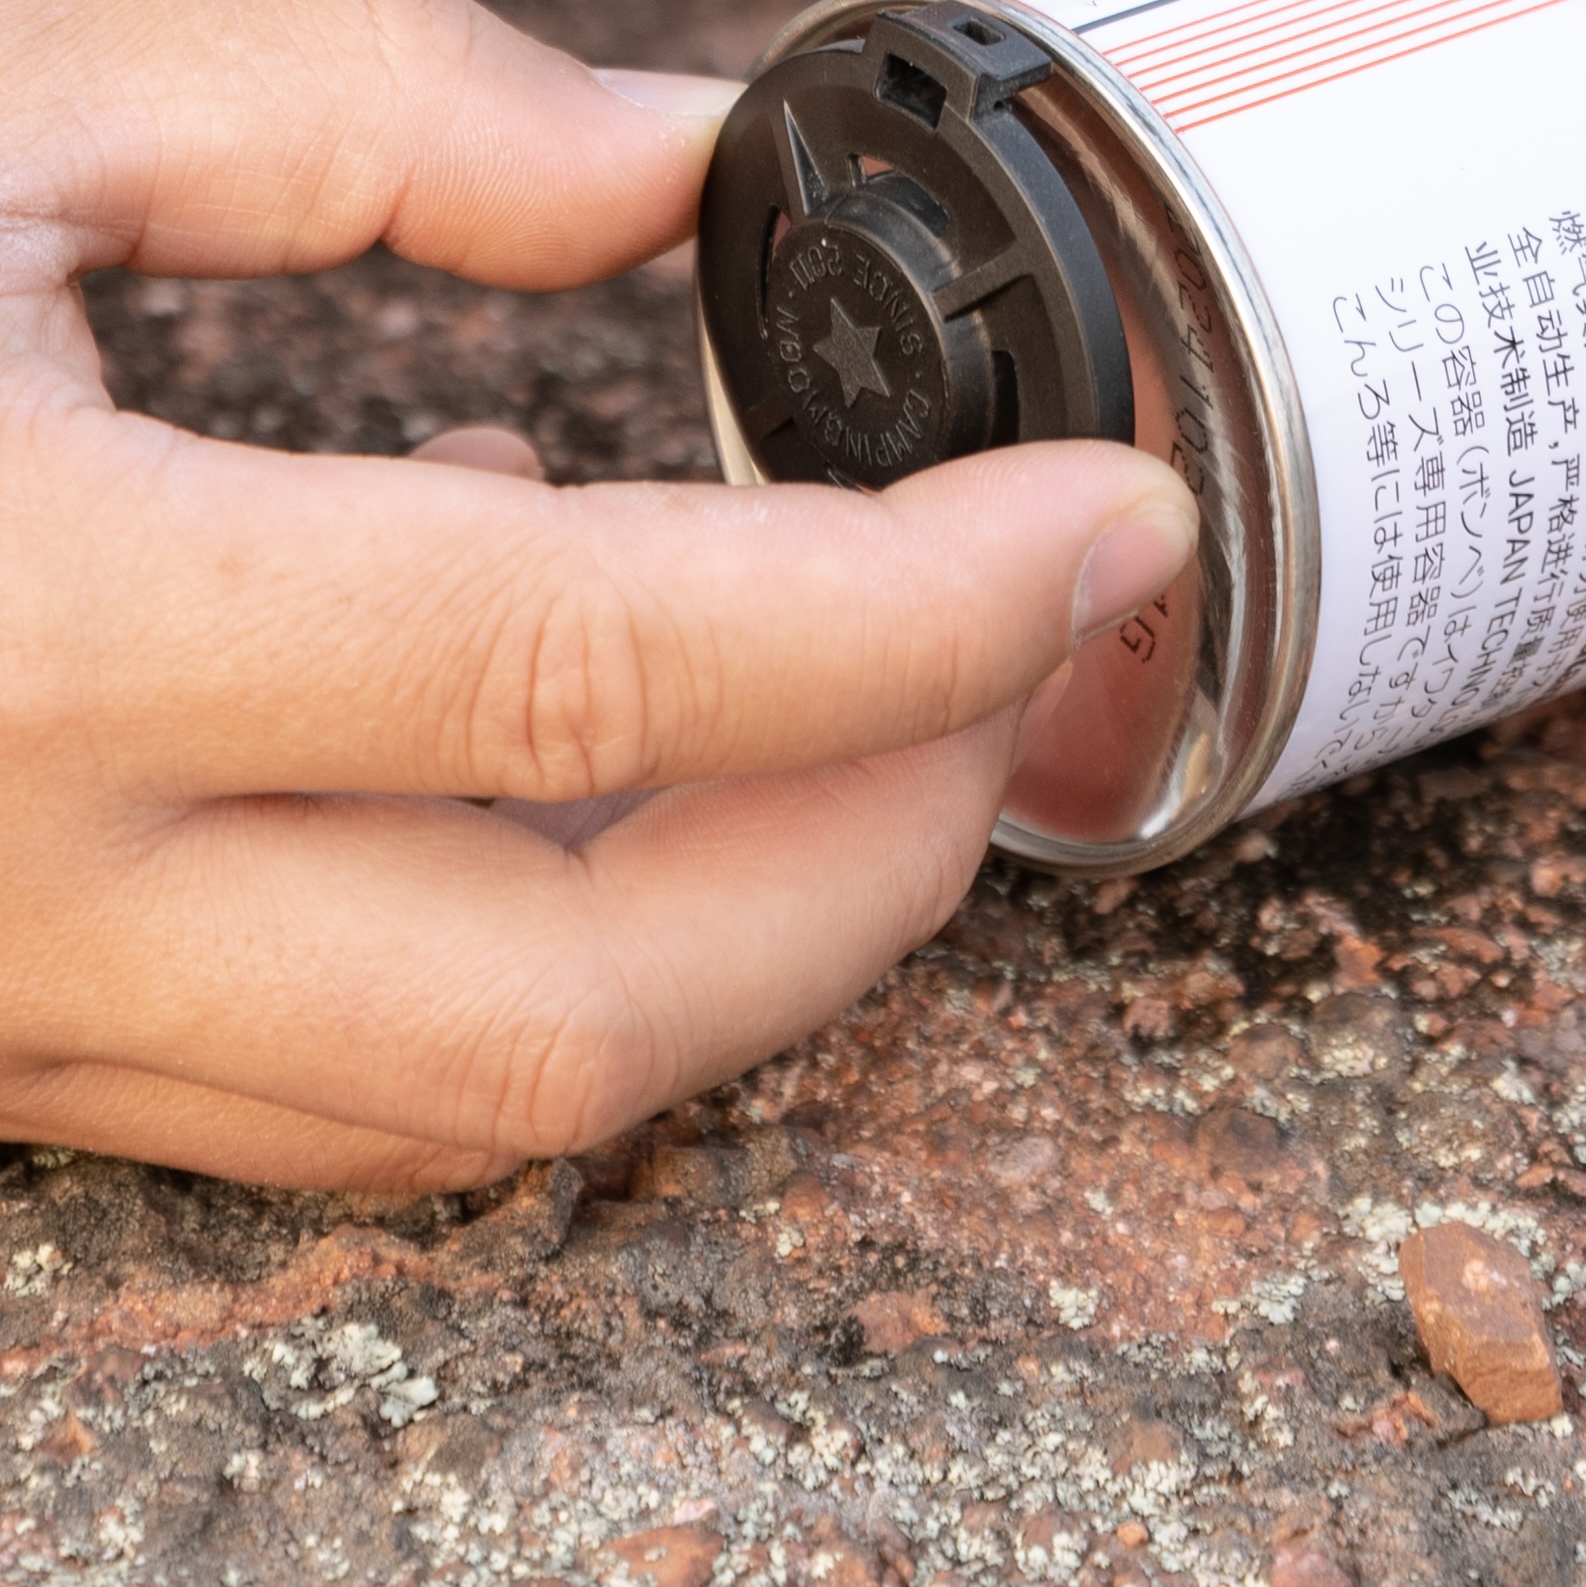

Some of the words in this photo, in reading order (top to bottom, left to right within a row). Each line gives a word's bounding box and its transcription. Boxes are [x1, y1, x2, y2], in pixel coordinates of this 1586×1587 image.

[851, 251, 926, 358] SINCE
[1464, 240, 1537, 457] 业技术制造
[1499, 467, 1537, 587] JAPAN
